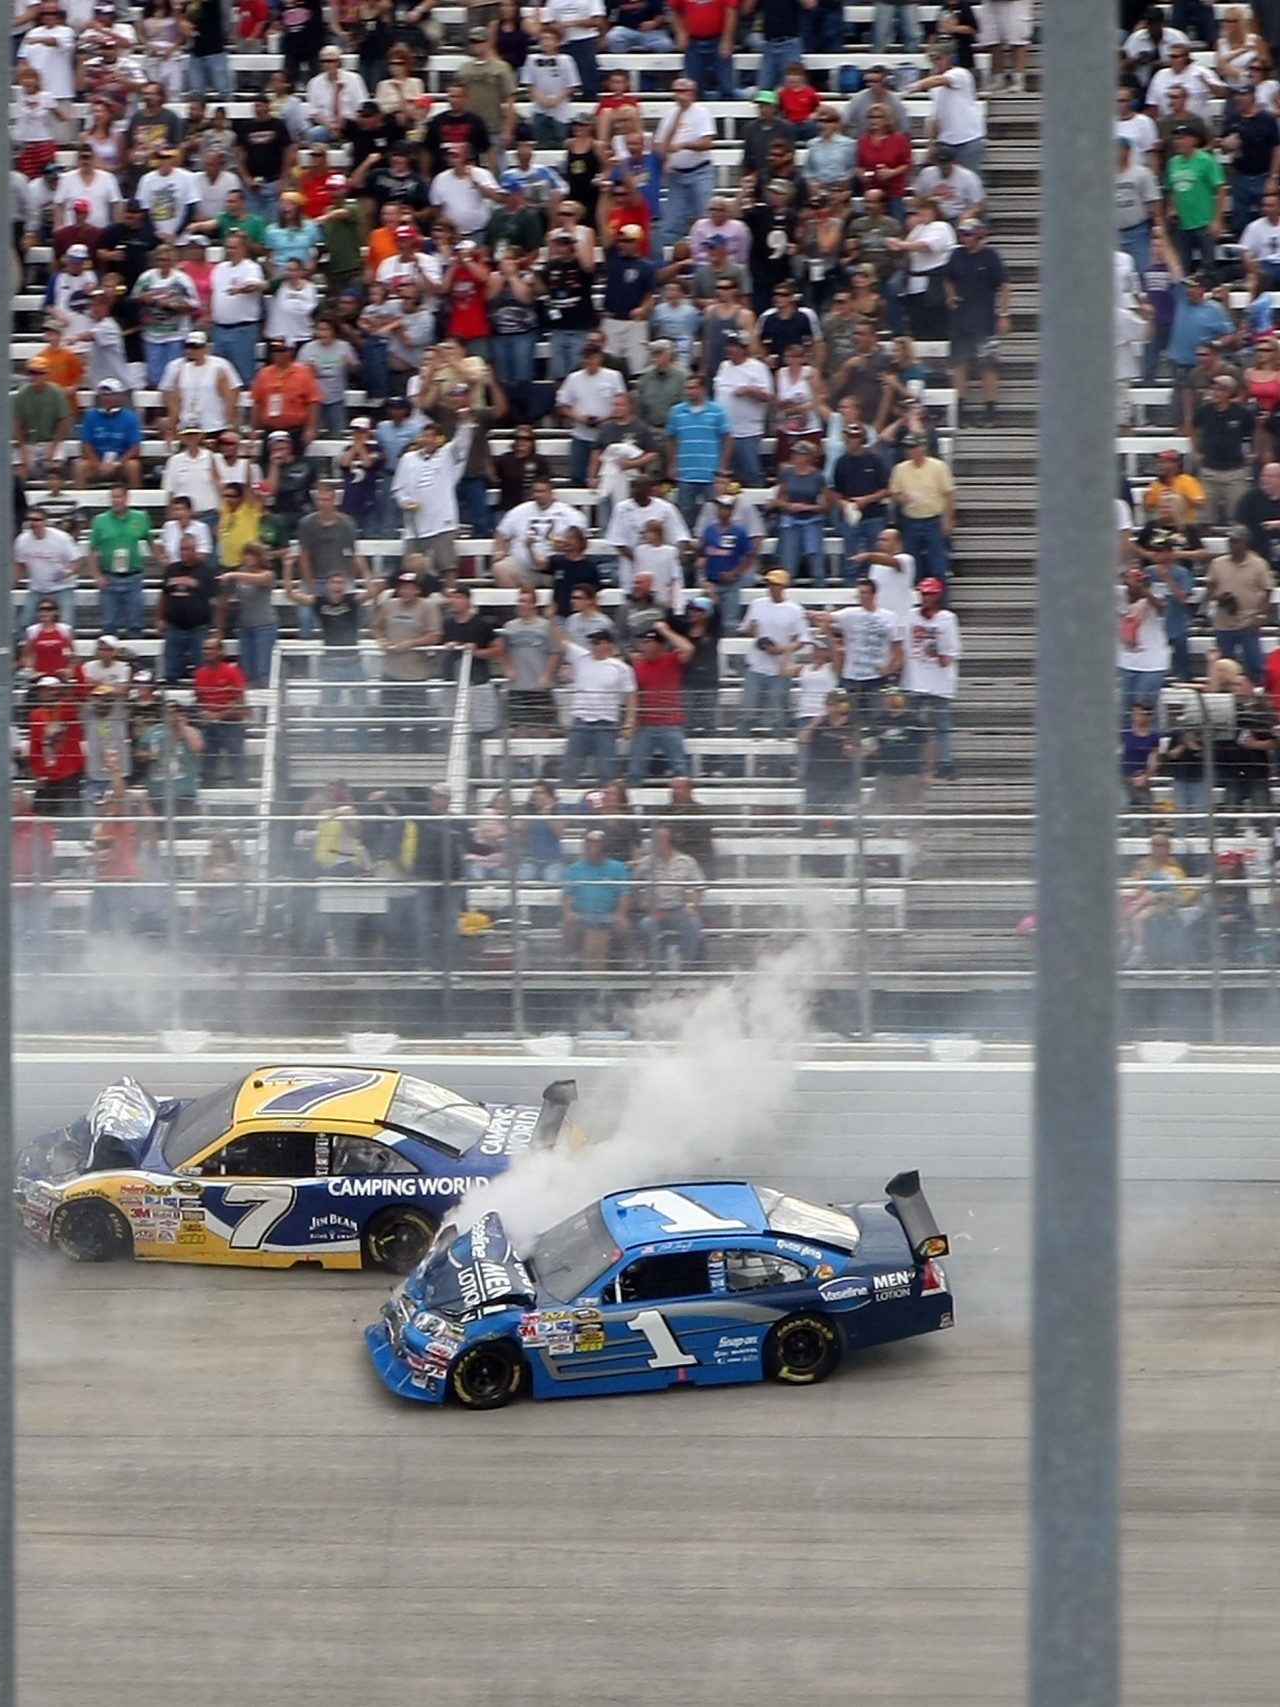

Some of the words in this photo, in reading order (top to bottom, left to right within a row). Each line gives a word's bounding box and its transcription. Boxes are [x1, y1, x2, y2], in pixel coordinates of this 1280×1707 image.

[257, 1069, 382, 1115] 7
[327, 1179, 415, 1197] CAMPING
[130, 1207, 151, 1219] 3M
[220, 1183, 298, 1251] 7
[619, 1188, 752, 1233] 1
[872, 1270, 910, 1290] MEN
[874, 1287, 911, 1303] LOTION
[519, 1325, 537, 1337] 3M
[626, 1309, 700, 1369] 1
